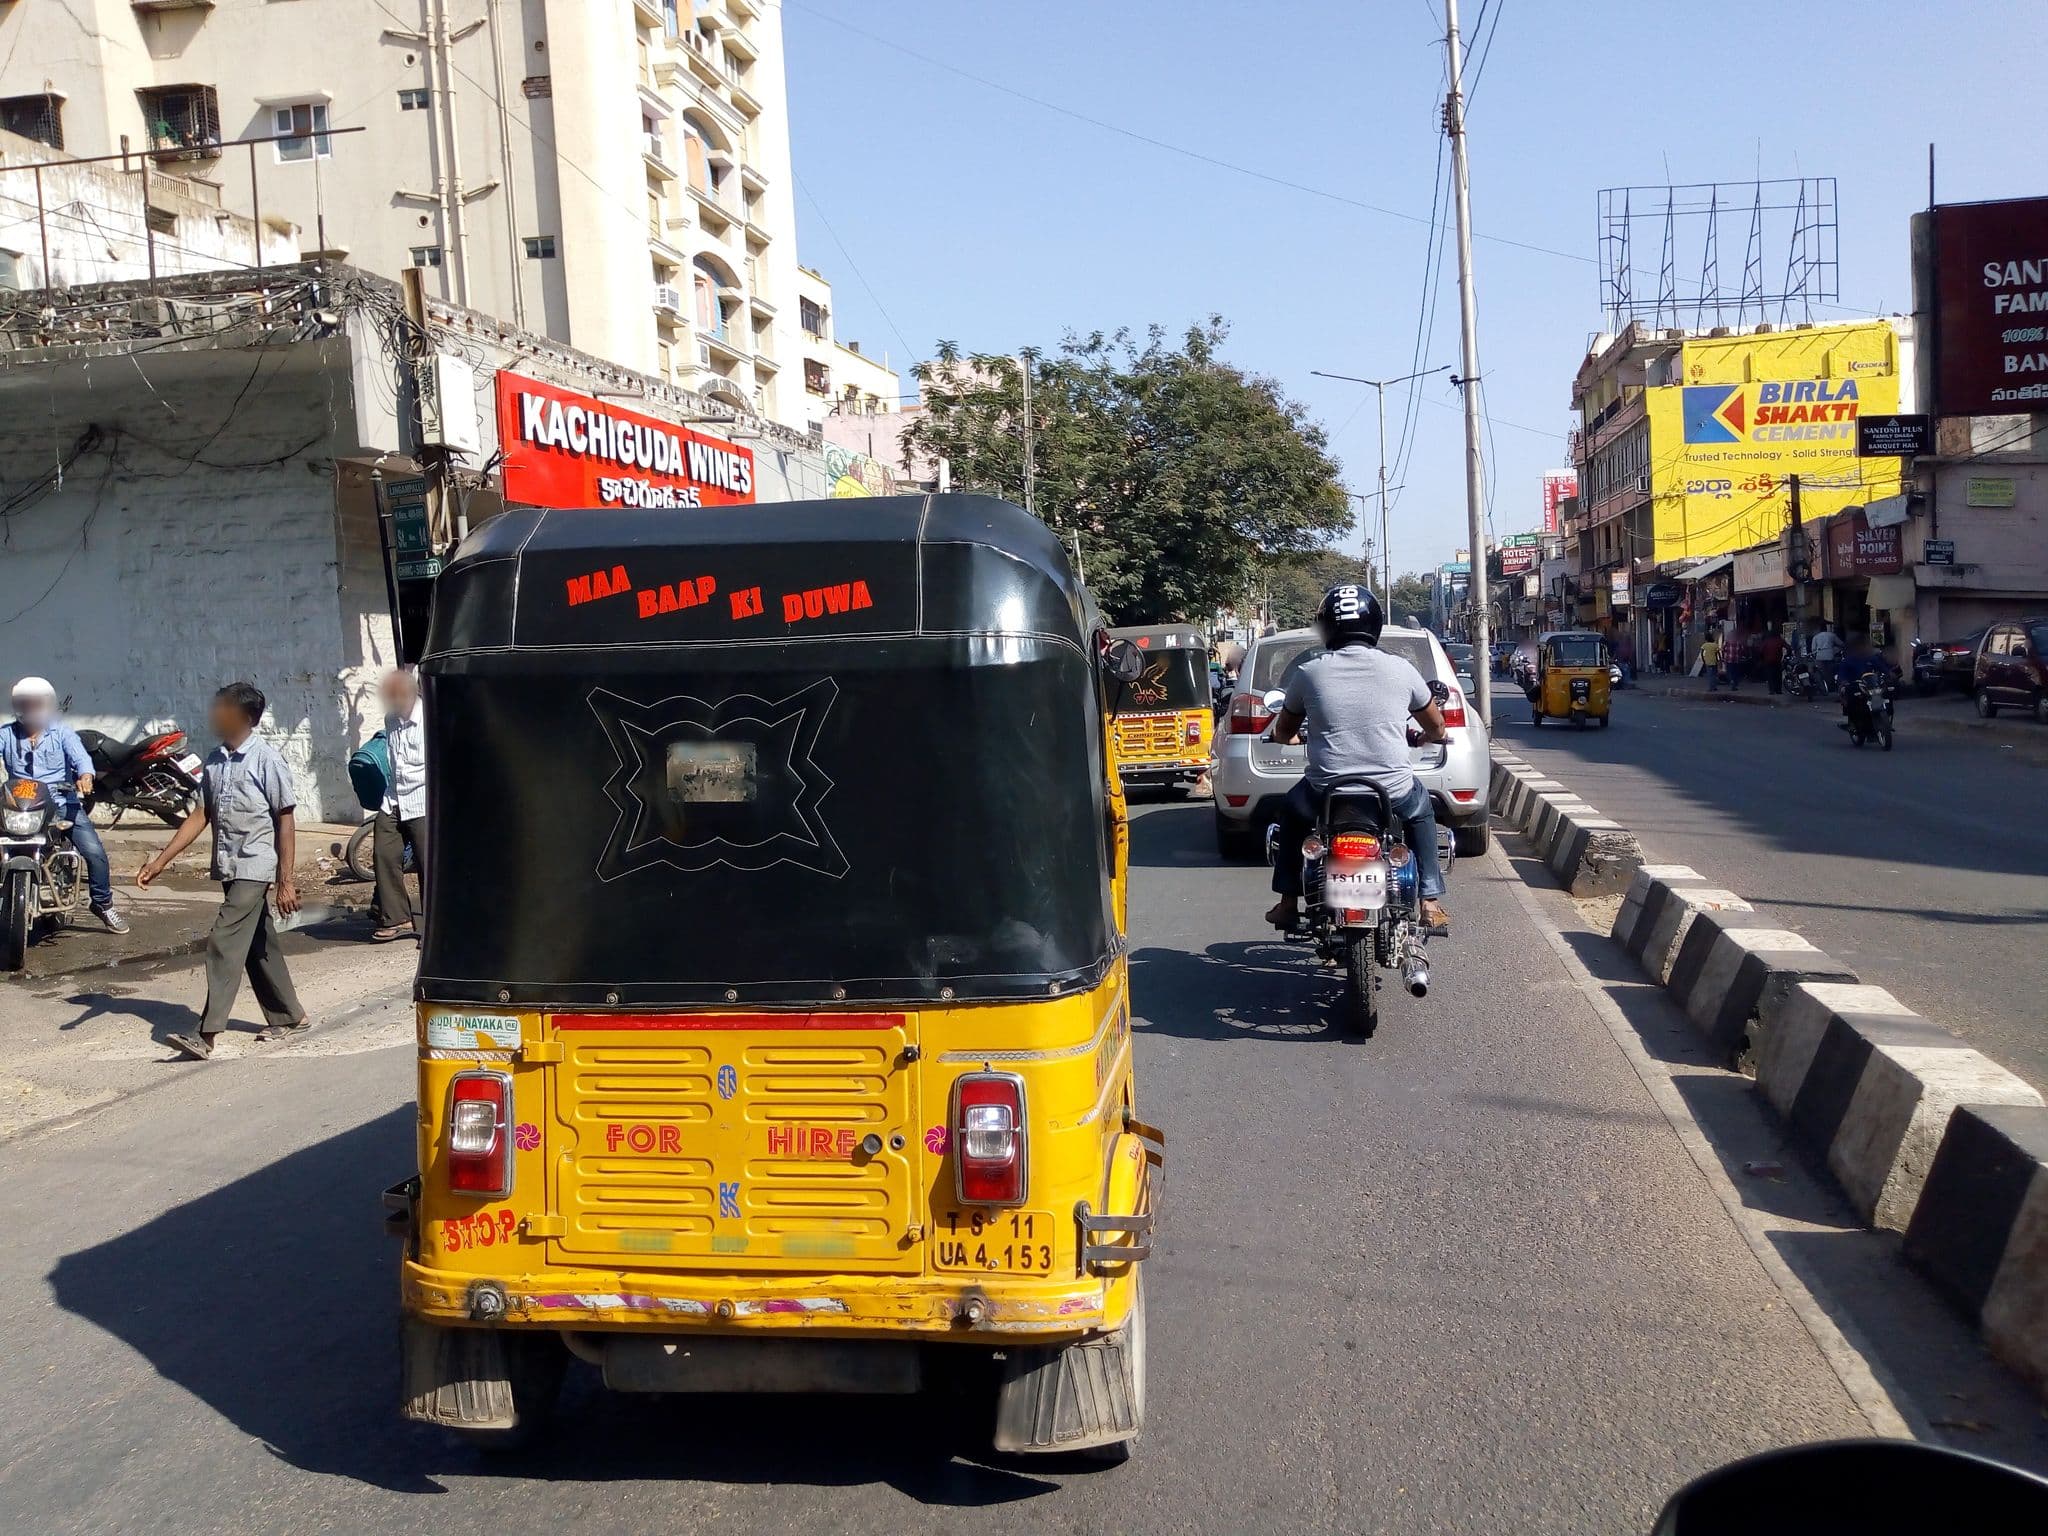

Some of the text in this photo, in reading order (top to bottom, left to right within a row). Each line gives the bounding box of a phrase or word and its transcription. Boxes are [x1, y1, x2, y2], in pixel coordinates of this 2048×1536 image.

[2002, 327, 2044, 343] 100%
[1759, 379, 1859, 404] BIRLA
[1753, 402, 1859, 425] SHAKTI
[1751, 424, 1856, 442] CEMENT
[522, 392, 751, 494] KACHIGUDA WINES
[1684, 452, 1720, 462] Trusted
[1722, 451, 1782, 463] Technology
[1792, 449, 1817, 458] Solid
[1686, 478, 1732, 499] బిర్లా
[1856, 528, 1897, 541] SILVER
[1502, 549, 1529, 558] HOTEL
[1859, 541, 1894, 554] POINT
[1503, 557, 1531, 565] ARIHANT
[566, 565, 873, 623] MAA BAAP KI DUWA
[1331, 873, 1346, 883] TS
[1351, 874, 1361, 883] 11
[606, 1124, 857, 1159] FOR HIRE
[440, 1208, 516, 1253] STOP
[1010, 1214, 1033, 1239] 11
